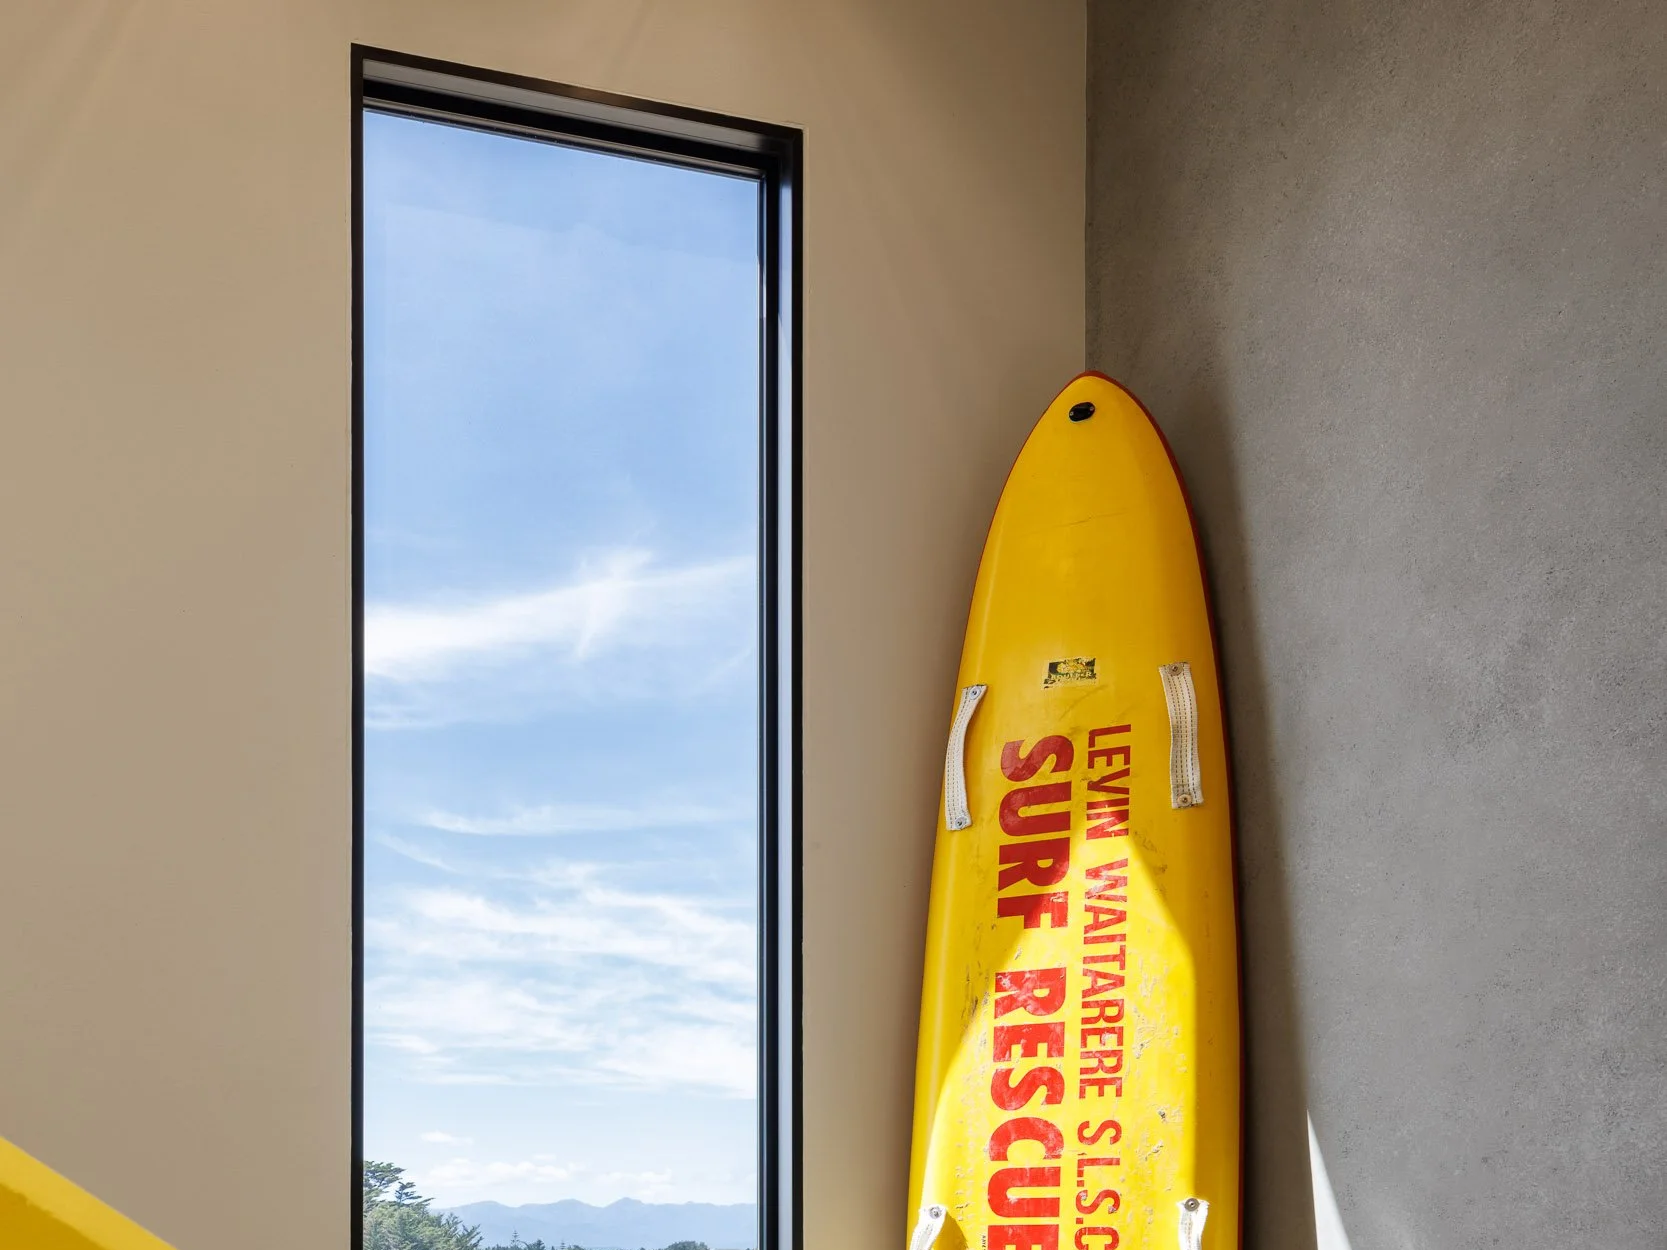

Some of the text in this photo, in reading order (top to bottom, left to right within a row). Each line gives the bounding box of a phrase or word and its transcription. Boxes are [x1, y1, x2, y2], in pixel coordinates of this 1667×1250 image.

[997, 735, 1074, 929] SURF
[1087, 724, 1131, 840] LEVIN
[1080, 858, 1128, 1098] WAITARERE
